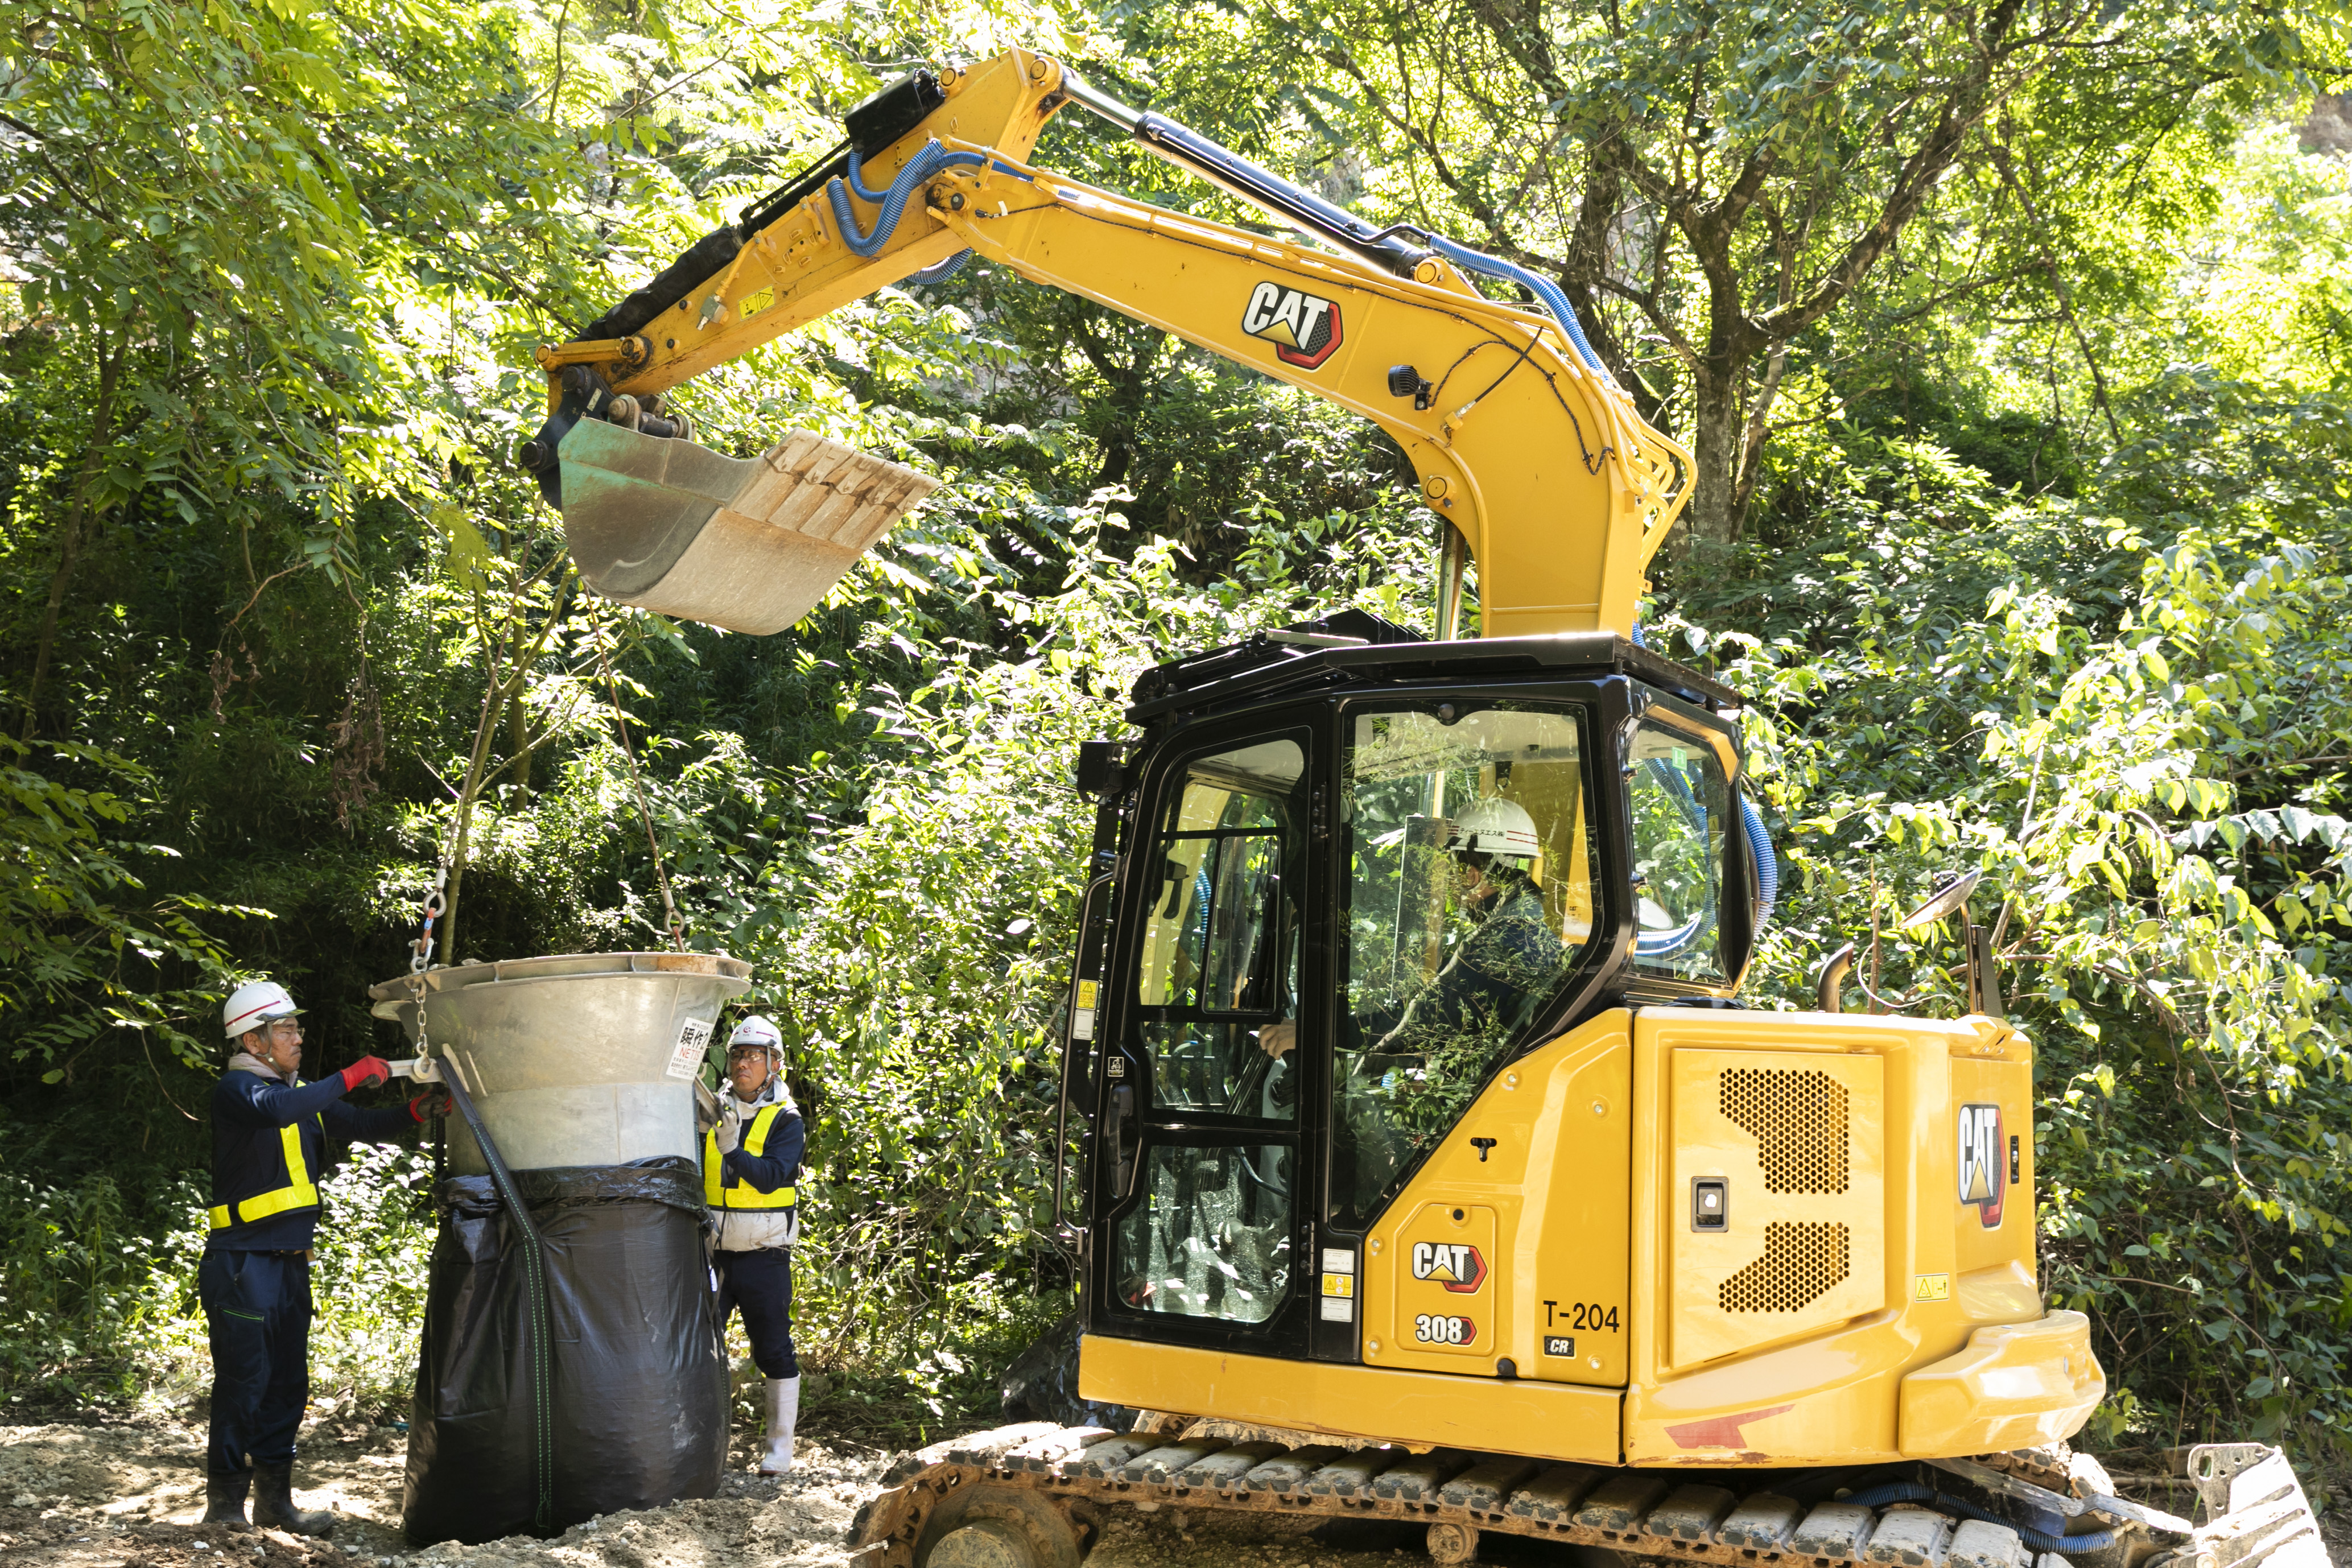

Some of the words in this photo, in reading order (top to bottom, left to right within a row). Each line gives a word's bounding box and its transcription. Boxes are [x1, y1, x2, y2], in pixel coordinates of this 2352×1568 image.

[1243, 282, 1330, 350] CAT
[679, 1047, 700, 1061] NETIS
[1959, 1107, 1996, 1200] CAT
[1413, 1242, 1469, 1282] CAT
[1416, 1315, 1462, 1343] 308
[1543, 1301, 1620, 1333] T-204
[1550, 1339, 1569, 1354] CR
